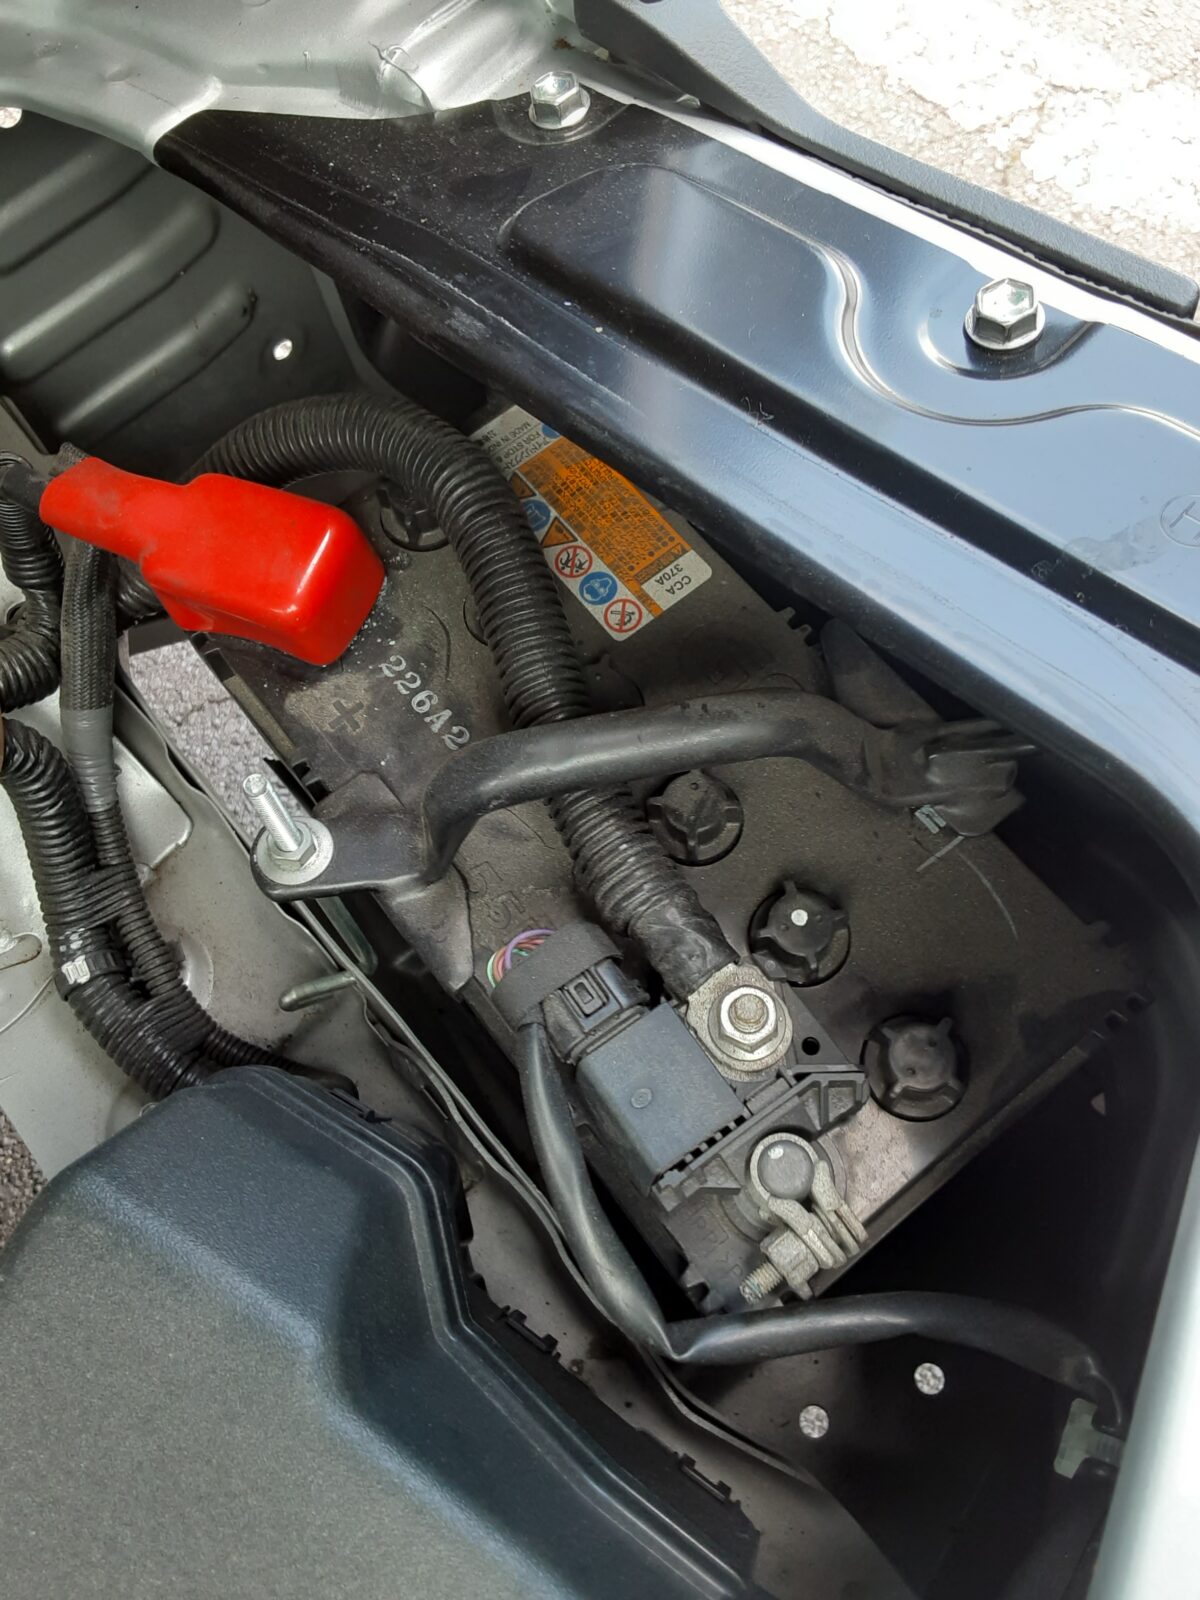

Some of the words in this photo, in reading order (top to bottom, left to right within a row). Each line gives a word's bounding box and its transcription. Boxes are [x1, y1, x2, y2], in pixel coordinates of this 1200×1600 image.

[523, 431, 541, 445] FOR
[654, 563, 683, 585] 370A
[665, 575, 692, 595] CCA
[379, 654, 470, 751] 226A2
